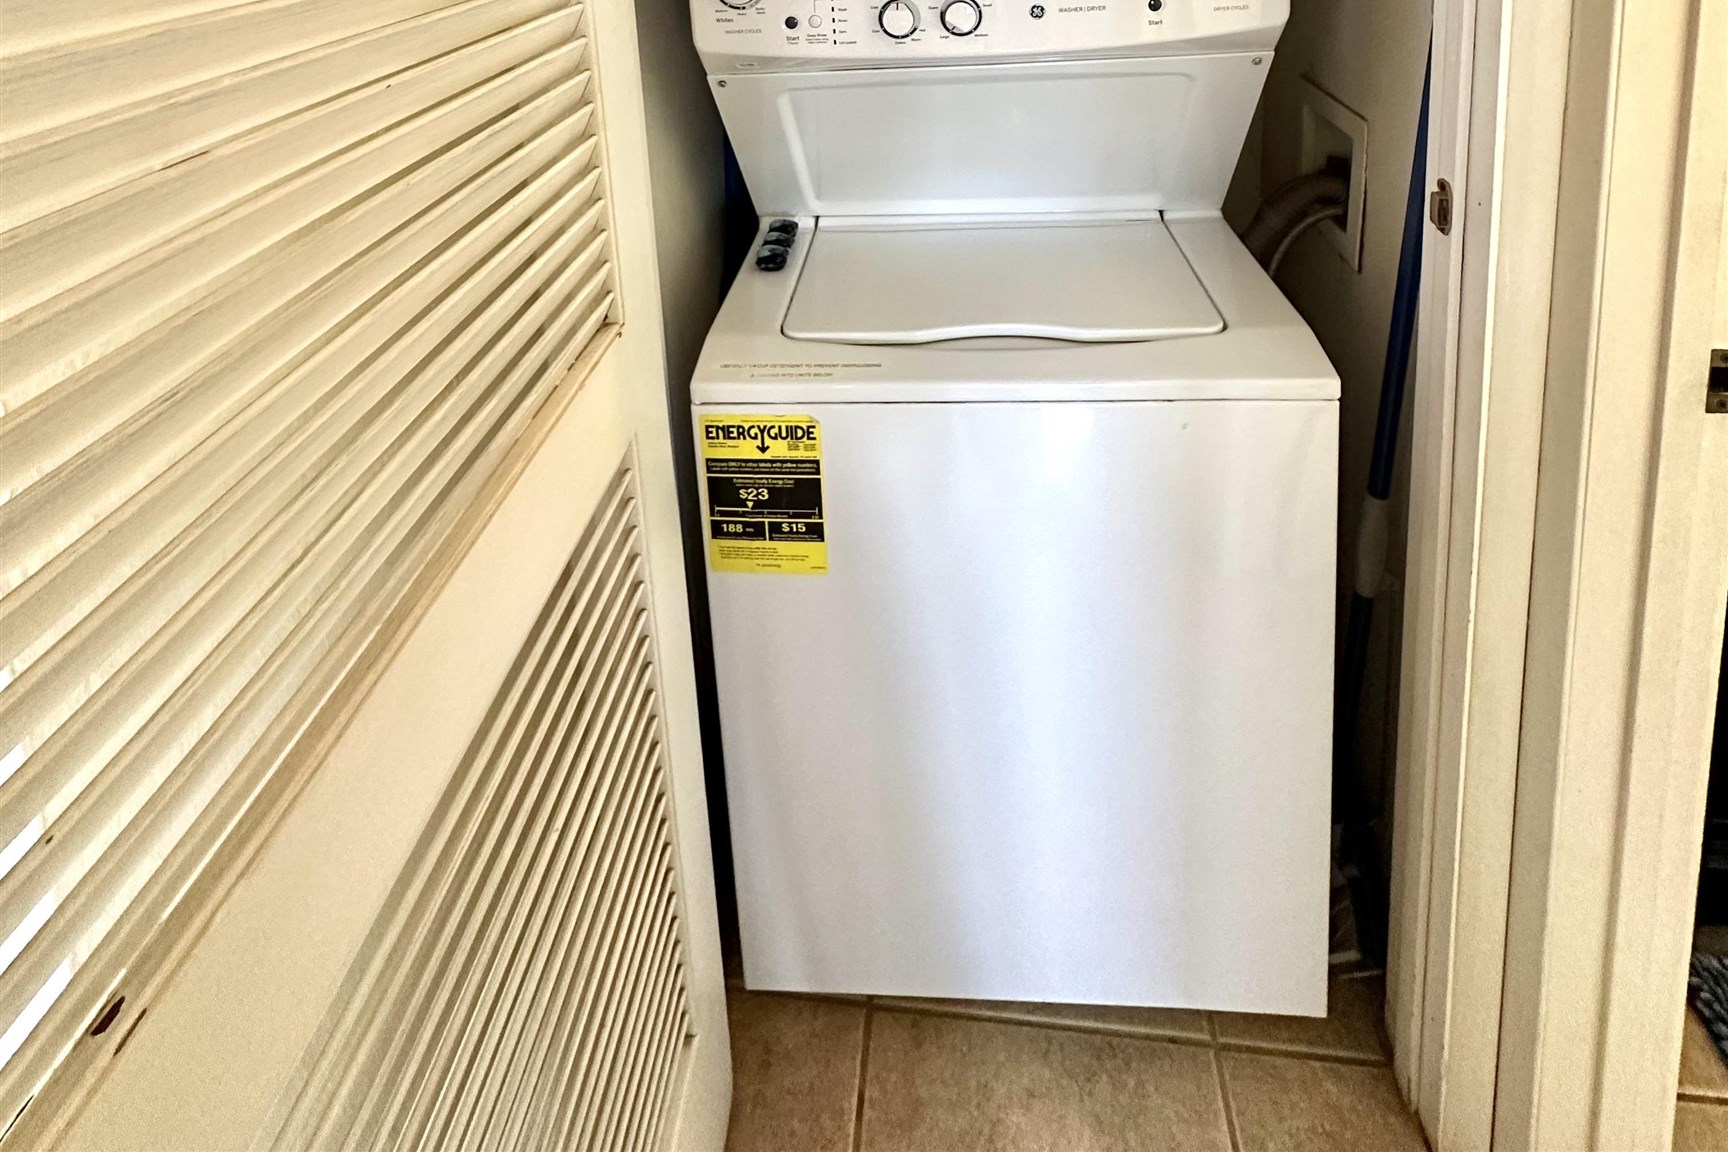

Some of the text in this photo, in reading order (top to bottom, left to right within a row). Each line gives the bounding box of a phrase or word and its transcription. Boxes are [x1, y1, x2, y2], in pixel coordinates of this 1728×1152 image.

[705, 424, 817, 441] ENERGYGUIDE
[739, 488, 769, 500] $23
[721, 523, 743, 533] 188
[781, 522, 806, 532] $15
